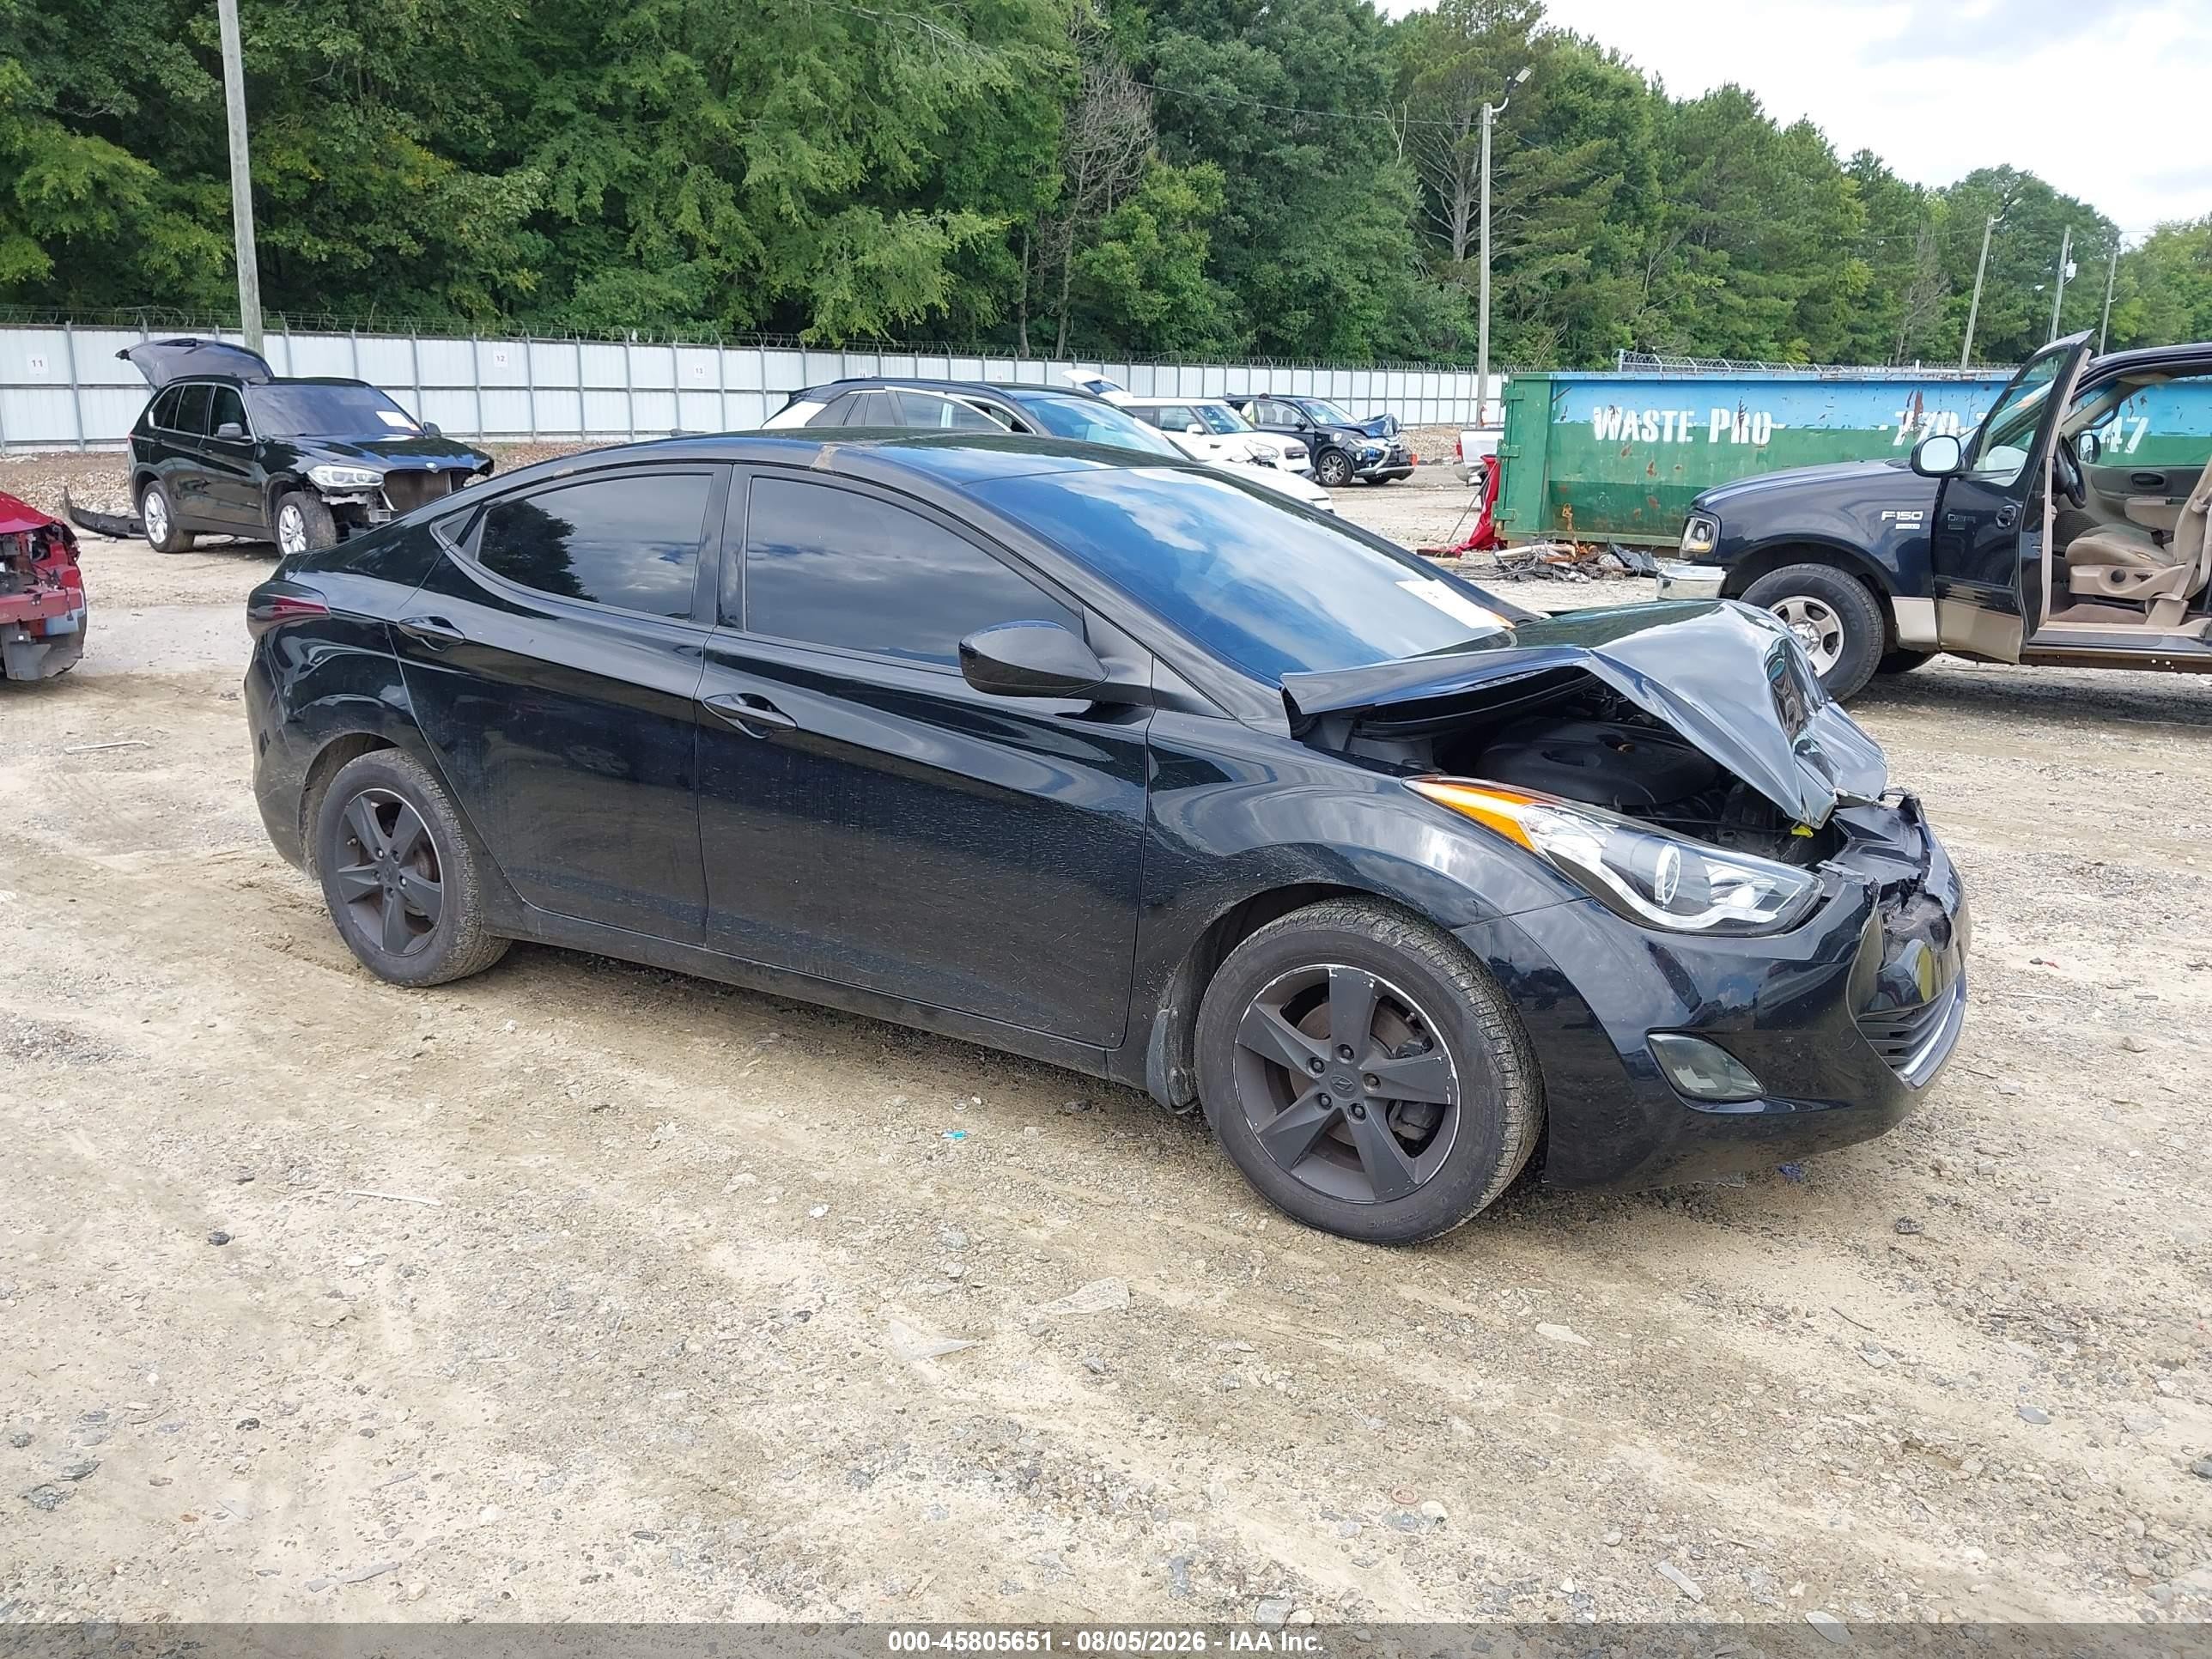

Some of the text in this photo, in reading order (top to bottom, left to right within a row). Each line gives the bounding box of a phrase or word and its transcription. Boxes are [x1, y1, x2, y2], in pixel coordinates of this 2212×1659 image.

[31, 359, 43, 368] 11
[1593, 405, 1772, 445] WASTE PRO
